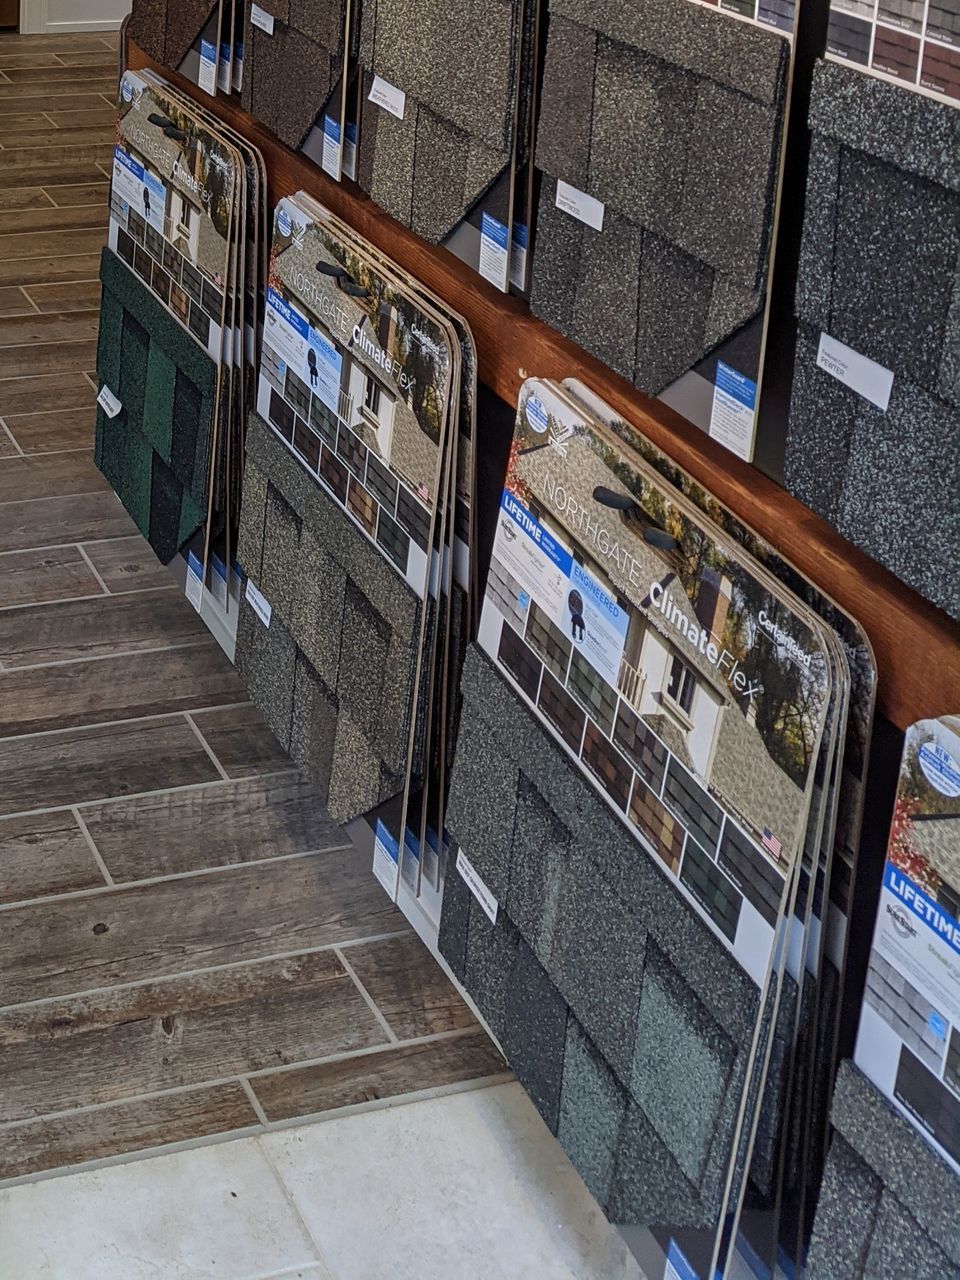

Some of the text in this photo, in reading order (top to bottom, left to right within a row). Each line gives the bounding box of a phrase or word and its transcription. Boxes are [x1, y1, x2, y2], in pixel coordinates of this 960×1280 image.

[268, 291, 291, 320] LIFETIME
[290, 266, 350, 333] NORTHGATE
[352, 324, 414, 391] ClimateFlex
[820, 355, 845, 377] PEWTER
[504, 495, 542, 541] LIFETIME
[542, 473, 643, 587] NORTHGATE
[574, 566, 620, 618] ENGINEERED
[649, 581, 760, 702] ClimateFlex
[758, 610, 812, 668] CertainTeed
[889, 871, 960, 947] LIFETIME
